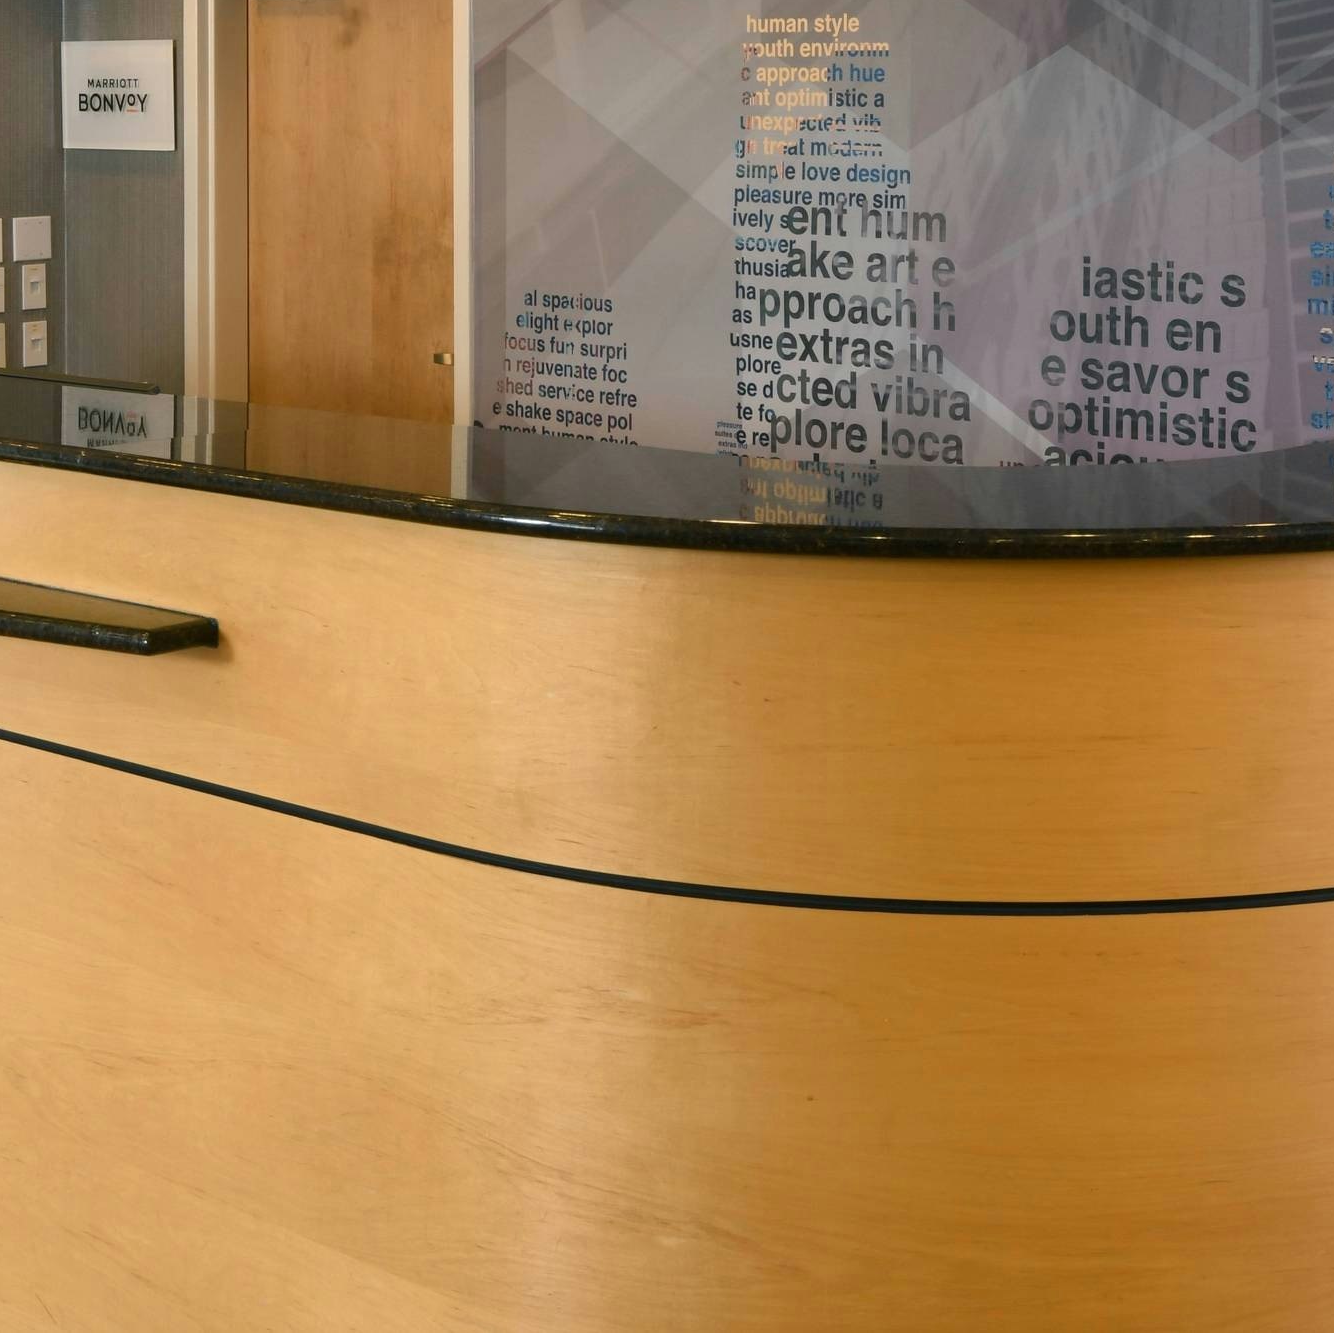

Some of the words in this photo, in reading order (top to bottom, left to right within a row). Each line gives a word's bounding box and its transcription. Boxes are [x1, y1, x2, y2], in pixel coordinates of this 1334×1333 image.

[746, 14, 808, 33] human
[814, 13, 860, 37] style
[742, 38, 794, 64] youth
[799, 38, 889, 57] environm
[87, 78, 139, 88] MARRIOTT
[756, 64, 843, 86] approach
[850, 63, 885, 82] hue
[78, 93, 147, 112] BONVOY
[775, 87, 868, 111] optimistic
[873, 92, 884, 107] a
[740, 113, 846, 135] unexpected
[810, 139, 883, 157] modern
[736, 161, 796, 184] simple
[801, 161, 841, 182] love
[846, 163, 911, 188] design
[734, 184, 812, 207] pleasure
[818, 190, 867, 209] more
[872, 189, 906, 209] sim
[733, 208, 774, 233] ively
[787, 202, 847, 237] ent
[861, 203, 947, 243] hum
[735, 236, 797, 254] scover
[787, 240, 854, 281] ake
[866, 248, 919, 285] art
[932, 256, 956, 287] e
[735, 280, 756, 300] ha
[1082, 256, 1204, 305] iastic
[1220, 274, 1246, 308] s
[524, 289, 537, 306] al
[542, 293, 613, 312] spacious
[759, 288, 918, 328] pproach
[933, 292, 956, 331] h
[516, 312, 559, 334] elight
[732, 308, 753, 324] as
[730, 332, 773, 350] usne
[1050, 305, 1149, 348] outh
[1166, 317, 1222, 353] en
[504, 332, 545, 352] focus
[550, 336, 574, 355] fun
[580, 342, 627, 363] surpri
[776, 328, 895, 370] extras
[910, 334, 944, 374] in
[516, 357, 597, 380] rejuvenate
[601, 364, 627, 383] foc
[736, 354, 782, 376] plore
[737, 381, 757, 395] se
[763, 381, 774, 399] d
[1041, 355, 1066, 387] e
[1081, 357, 1210, 399] savor
[1225, 370, 1252, 404] s
[497, 377, 533, 396] shed
[538, 383, 594, 403] service
[599, 389, 638, 408] refre
[777, 369, 857, 410] cted
[870, 375, 971, 422] vibra
[492, 401, 502, 414] e
[506, 400, 551, 421] shake
[556, 408, 603, 427] space
[607, 413, 633, 433] pol
[737, 402, 753, 421] te
[1028, 396, 1257, 452] optimistic
[752, 430, 770, 447] re
[770, 409, 868, 454] plore
[881, 417, 964, 465] loca
